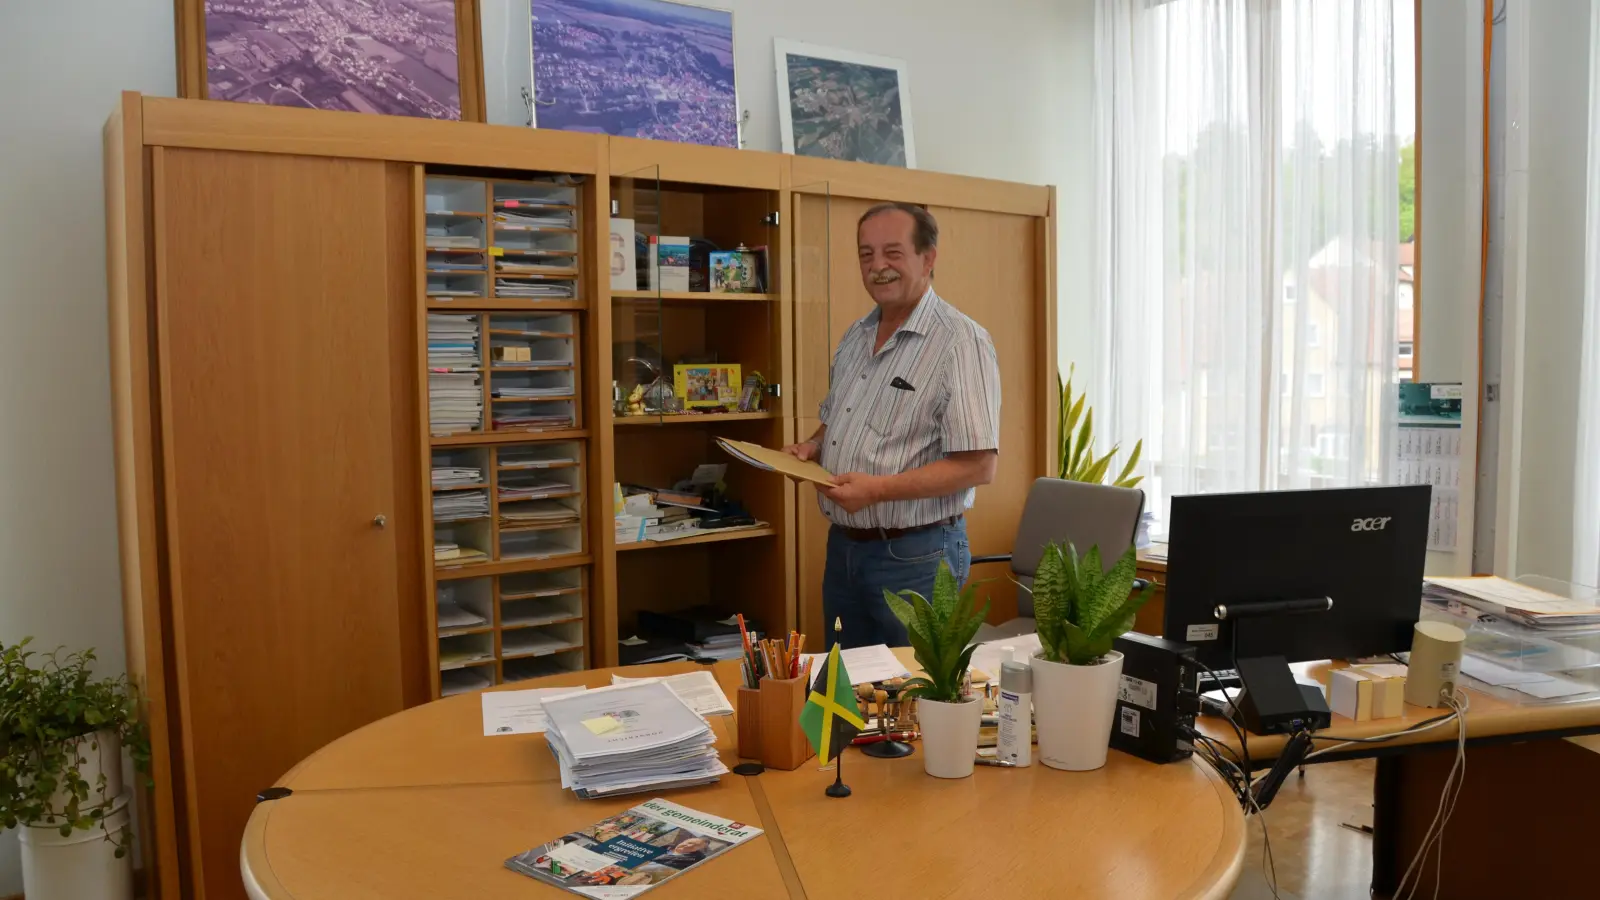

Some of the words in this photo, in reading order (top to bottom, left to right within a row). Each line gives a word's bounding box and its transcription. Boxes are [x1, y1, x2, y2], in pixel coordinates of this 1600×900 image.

[1351, 516, 1392, 531] acer
[642, 802, 665, 812] der
[661, 808, 748, 838] gemeinderat
[608, 844, 645, 859] ergreifen
[616, 839, 654, 854] Initiative
